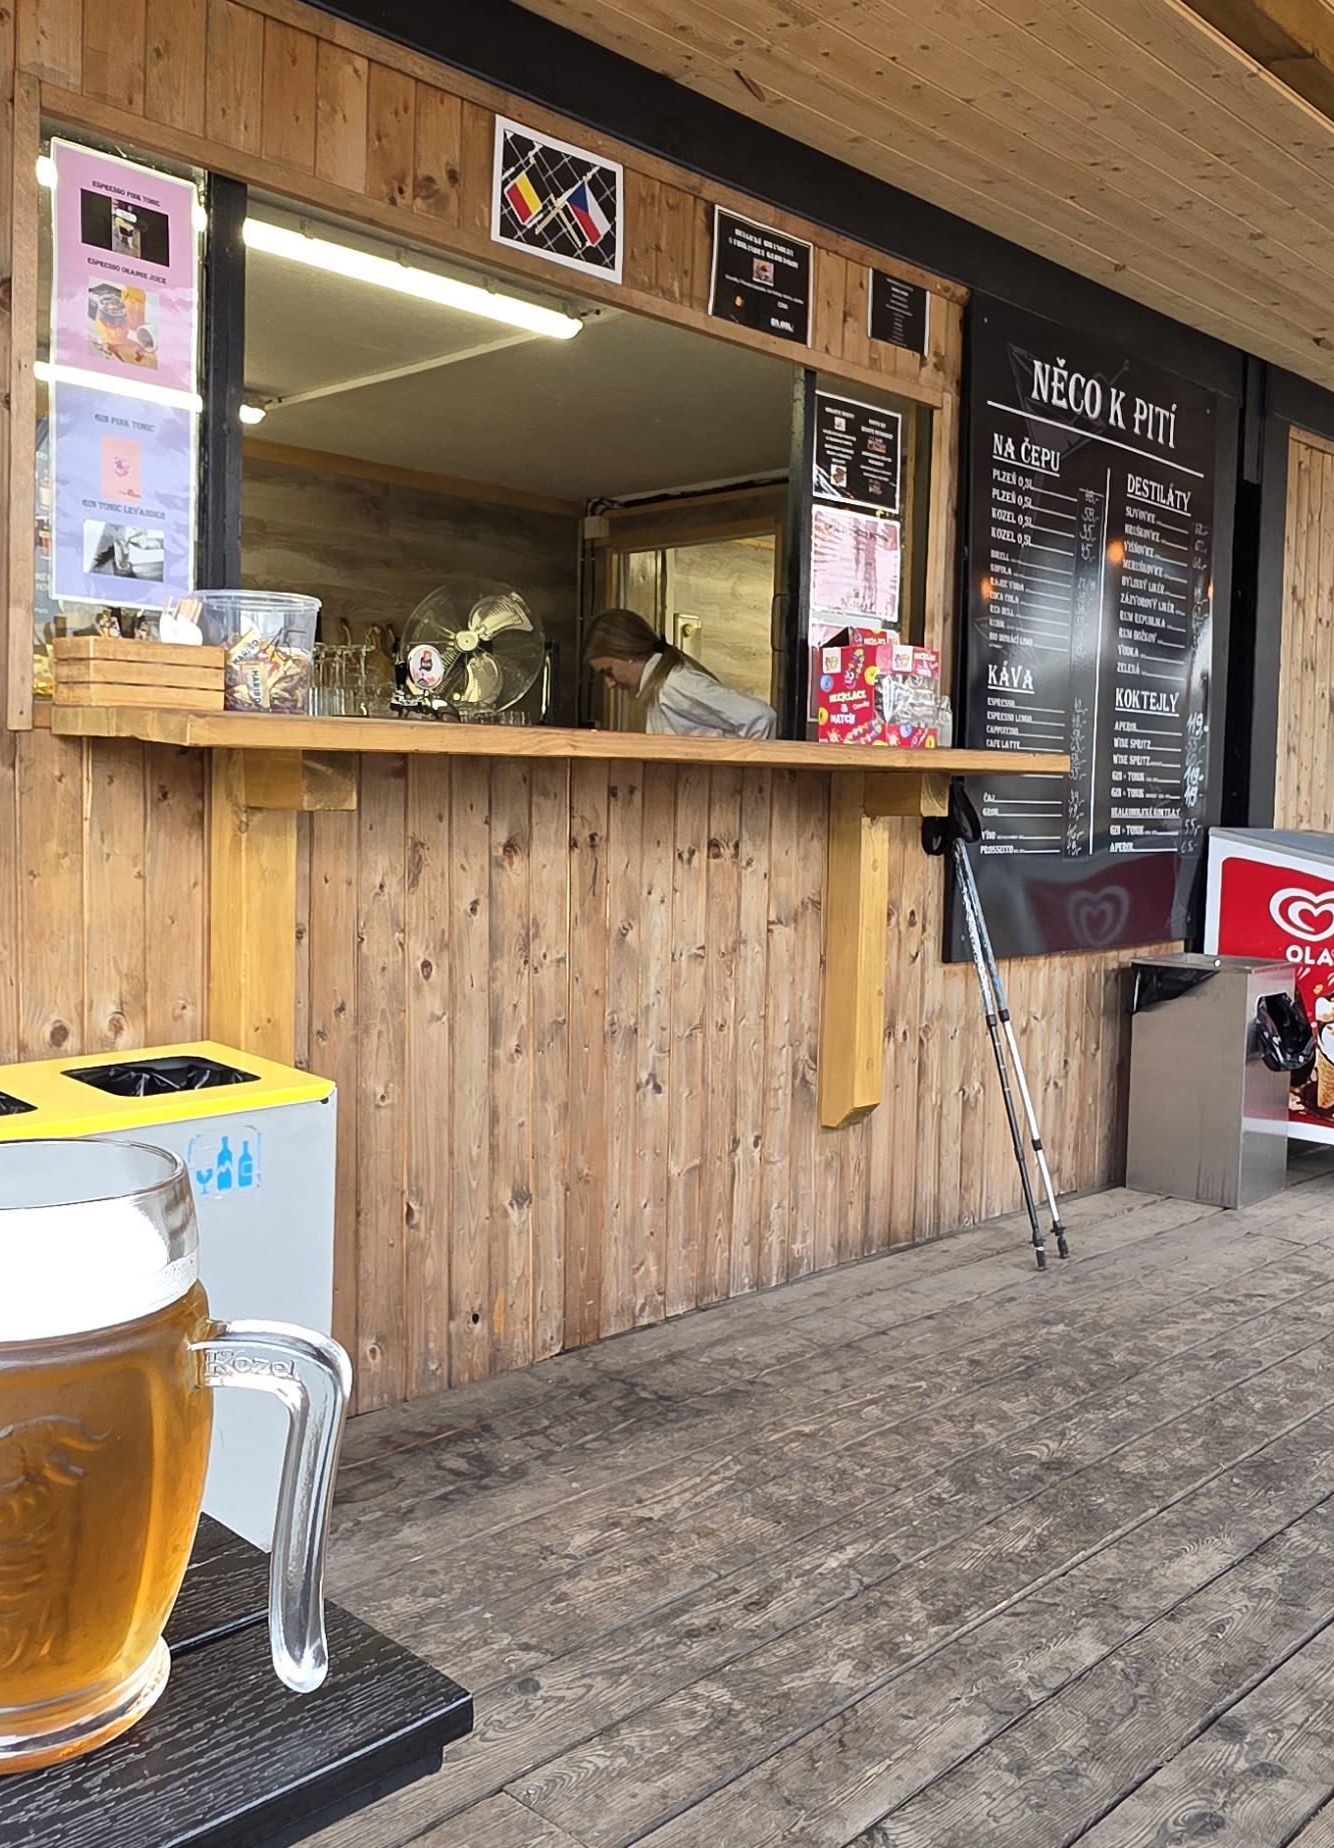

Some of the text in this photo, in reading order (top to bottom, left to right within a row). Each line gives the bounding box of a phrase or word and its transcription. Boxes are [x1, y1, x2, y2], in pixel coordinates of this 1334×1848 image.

[1031, 356, 1177, 448] NĚCO K PITÍ
[993, 432, 1060, 472] NA ČEPU
[992, 468, 1016, 485] PLZEŇ
[991, 487, 1016, 504] PLZEŇ
[1127, 473, 1191, 512] DESTILÁTY
[991, 507, 1016, 524] KOZEL
[990, 526, 1016, 543] KOZEL
[233, 639, 259, 665] HARIBO
[252, 670, 261, 704] HARIBO
[987, 660, 1034, 690] KÁVA
[1115, 687, 1180, 712] KOKTEJLY
